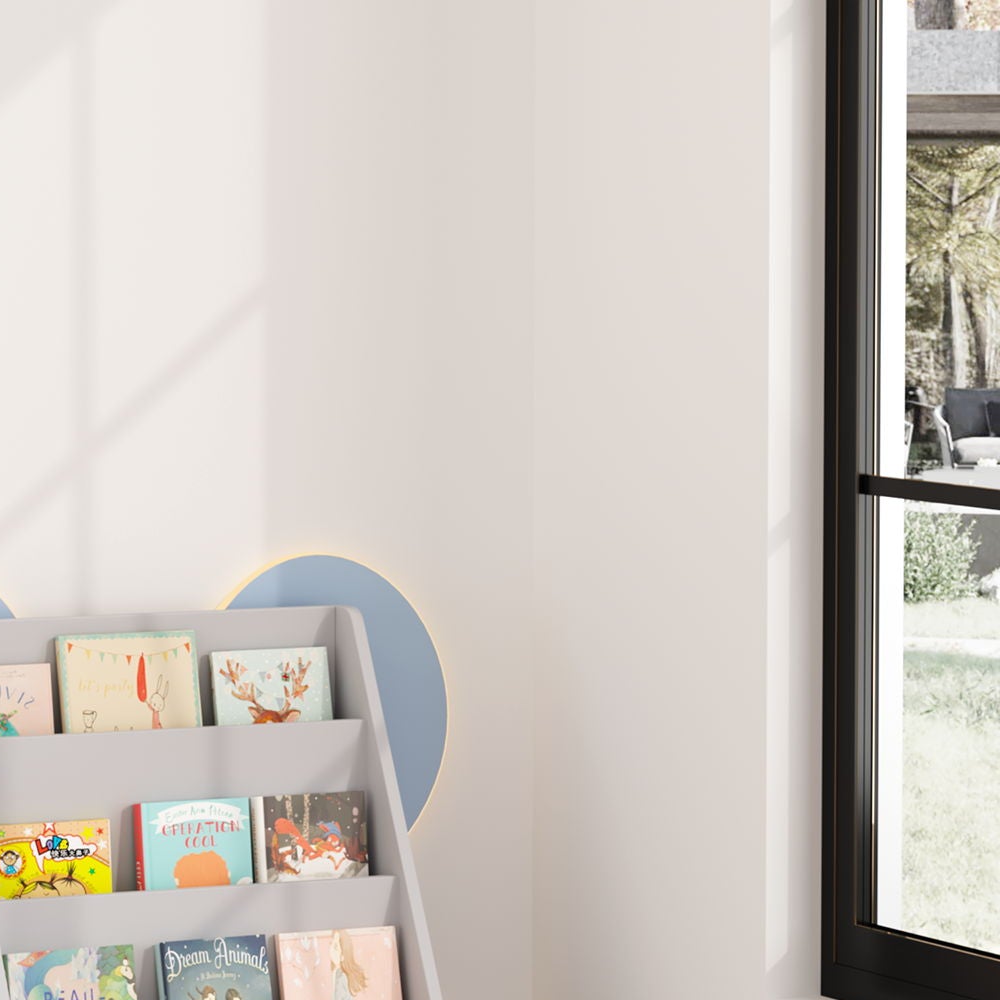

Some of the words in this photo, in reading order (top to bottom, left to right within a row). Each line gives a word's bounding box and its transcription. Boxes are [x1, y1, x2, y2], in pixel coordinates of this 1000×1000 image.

[161, 820, 240, 836] OPERATION
[184, 835, 216, 848] COOL
[164, 946, 212, 982] Dream
[214, 937, 269, 974] Animals
